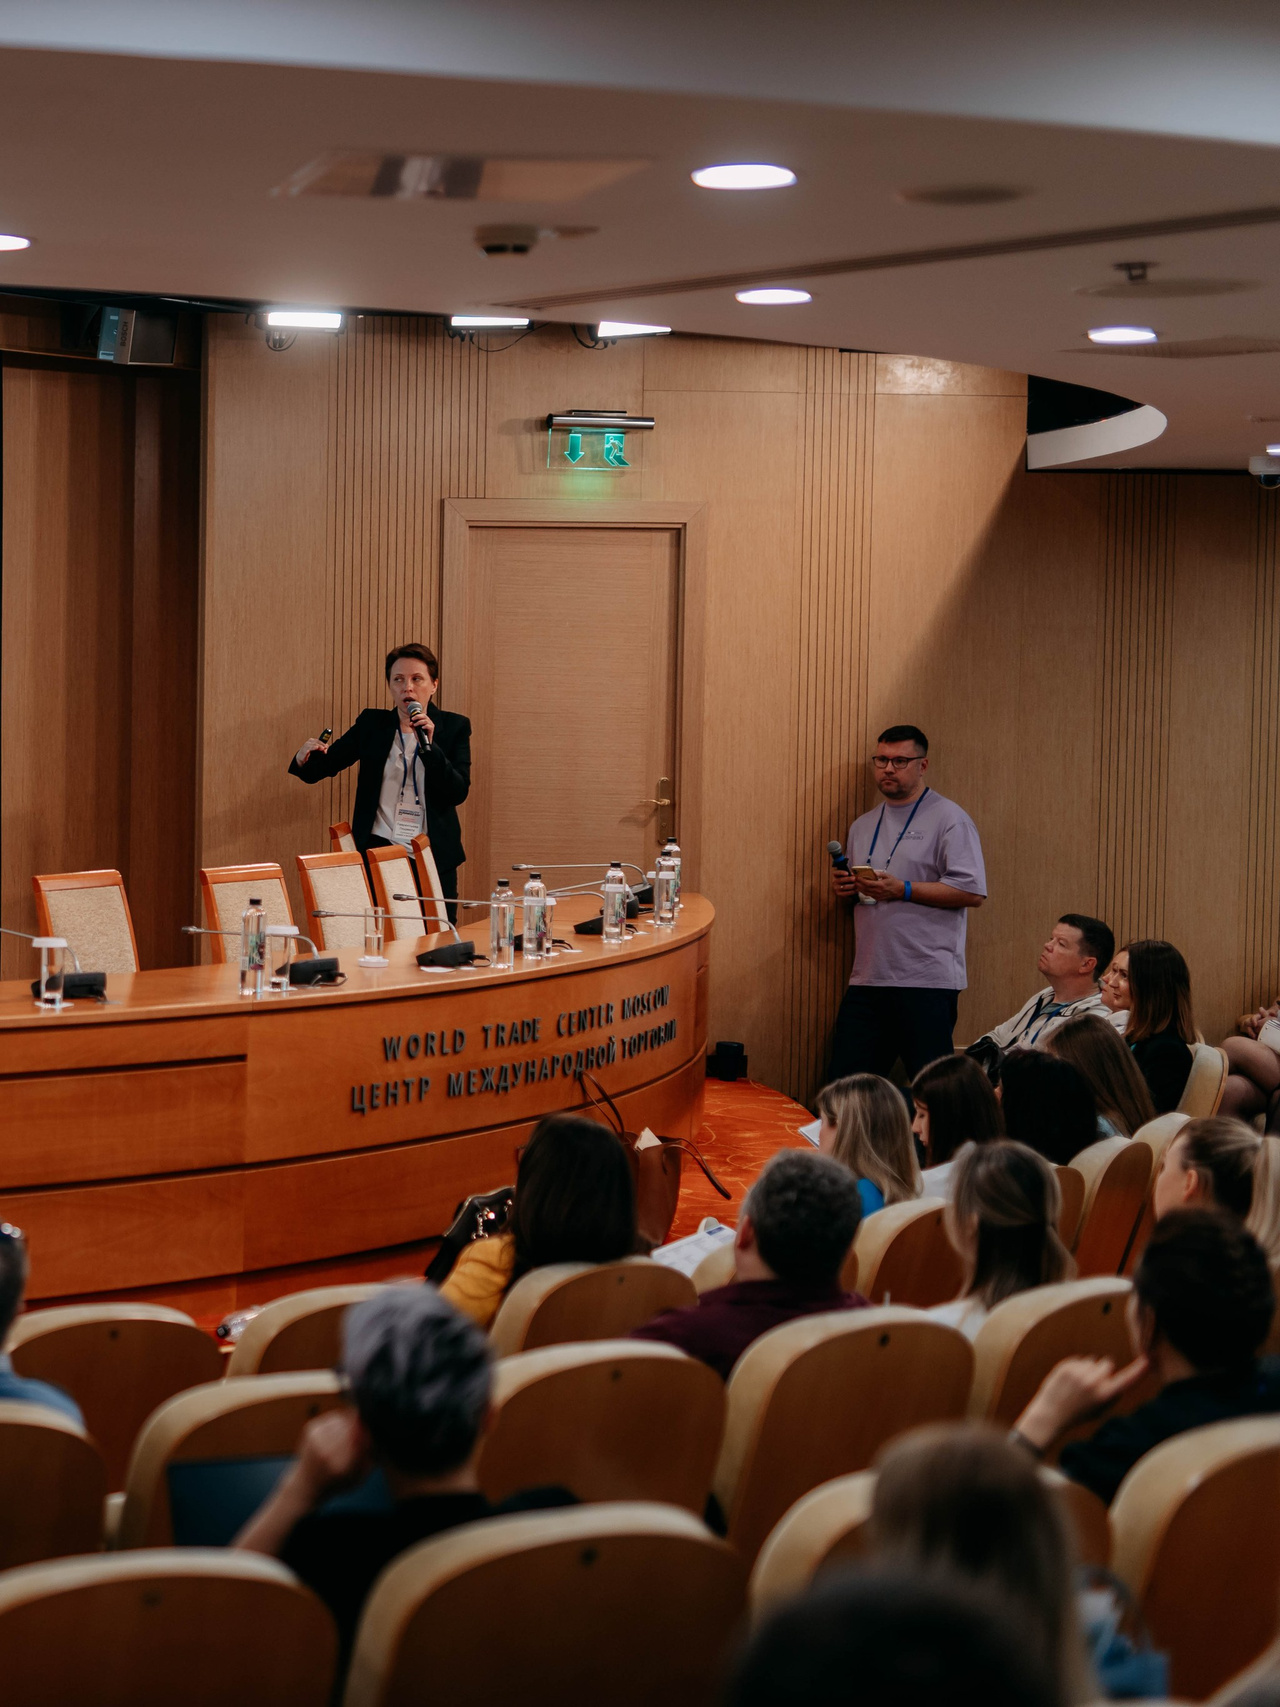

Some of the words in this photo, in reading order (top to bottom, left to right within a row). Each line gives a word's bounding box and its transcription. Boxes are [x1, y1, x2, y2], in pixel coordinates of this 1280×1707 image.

[120, 321, 128, 346] BOSCH
[383, 1029, 466, 1061] WORLD
[482, 1017, 542, 1048] TRADE
[557, 1002, 615, 1036] CENTER
[622, 985, 670, 1020] MOSCOW
[351, 1077, 432, 1115] ЦЕНТР
[448, 1035, 618, 1097] МЕЖДУНАРОДНОЙ
[621, 1019, 677, 1059] ТОРГОВЛИ
